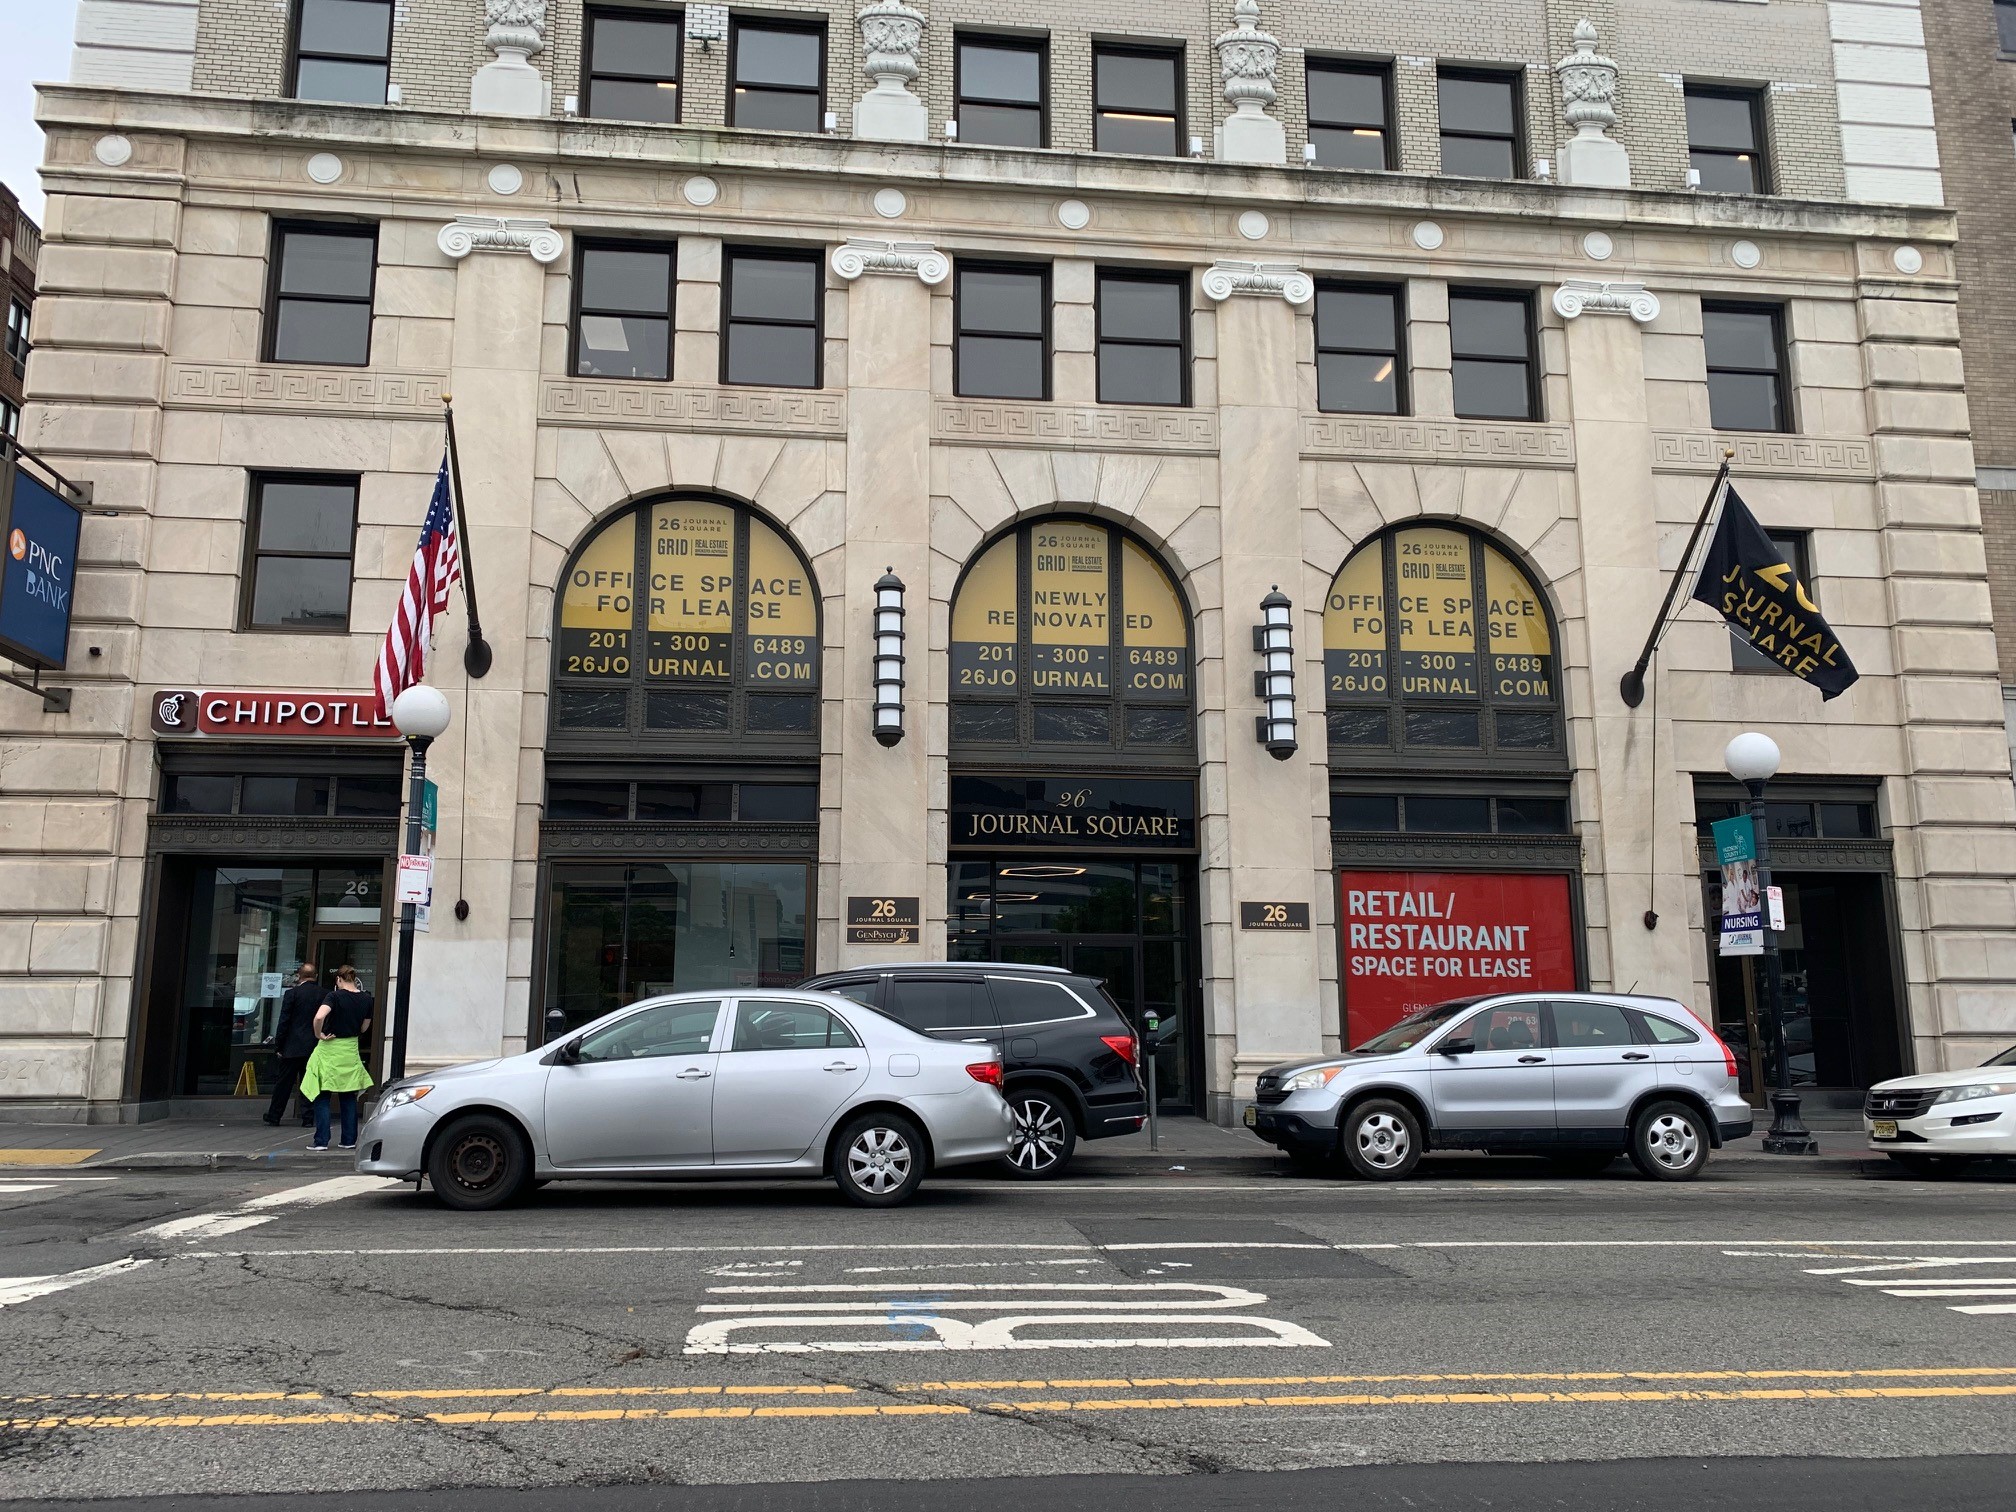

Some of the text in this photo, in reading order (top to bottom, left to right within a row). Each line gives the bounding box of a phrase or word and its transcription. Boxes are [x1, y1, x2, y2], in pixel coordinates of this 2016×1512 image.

[659, 518, 680, 530] 26
[658, 538, 688, 555] GRID
[1038, 535, 1057, 547] 26
[1402, 543, 1421, 555] 26
[29, 540, 62, 581] PNC
[1037, 554, 1065, 571] GRID
[1402, 562, 1430, 579] GRID
[26, 569, 67, 613] BANK
[1034, 591, 1106, 606] NEWLY
[1056, 789, 1092, 808] 26
[969, 814, 1179, 838] JOURNAL SQUARE
[345, 881, 368, 895] 26
[871, 899, 896, 917] 26
[1263, 904, 1288, 922] 26
[1724, 915, 1758, 929] NURSING
[1350, 923, 1530, 951] RESTAURANT
[1351, 956, 1532, 978] SPACE FOR LEASE
[1402, 1003, 1431, 1013] GLEN
